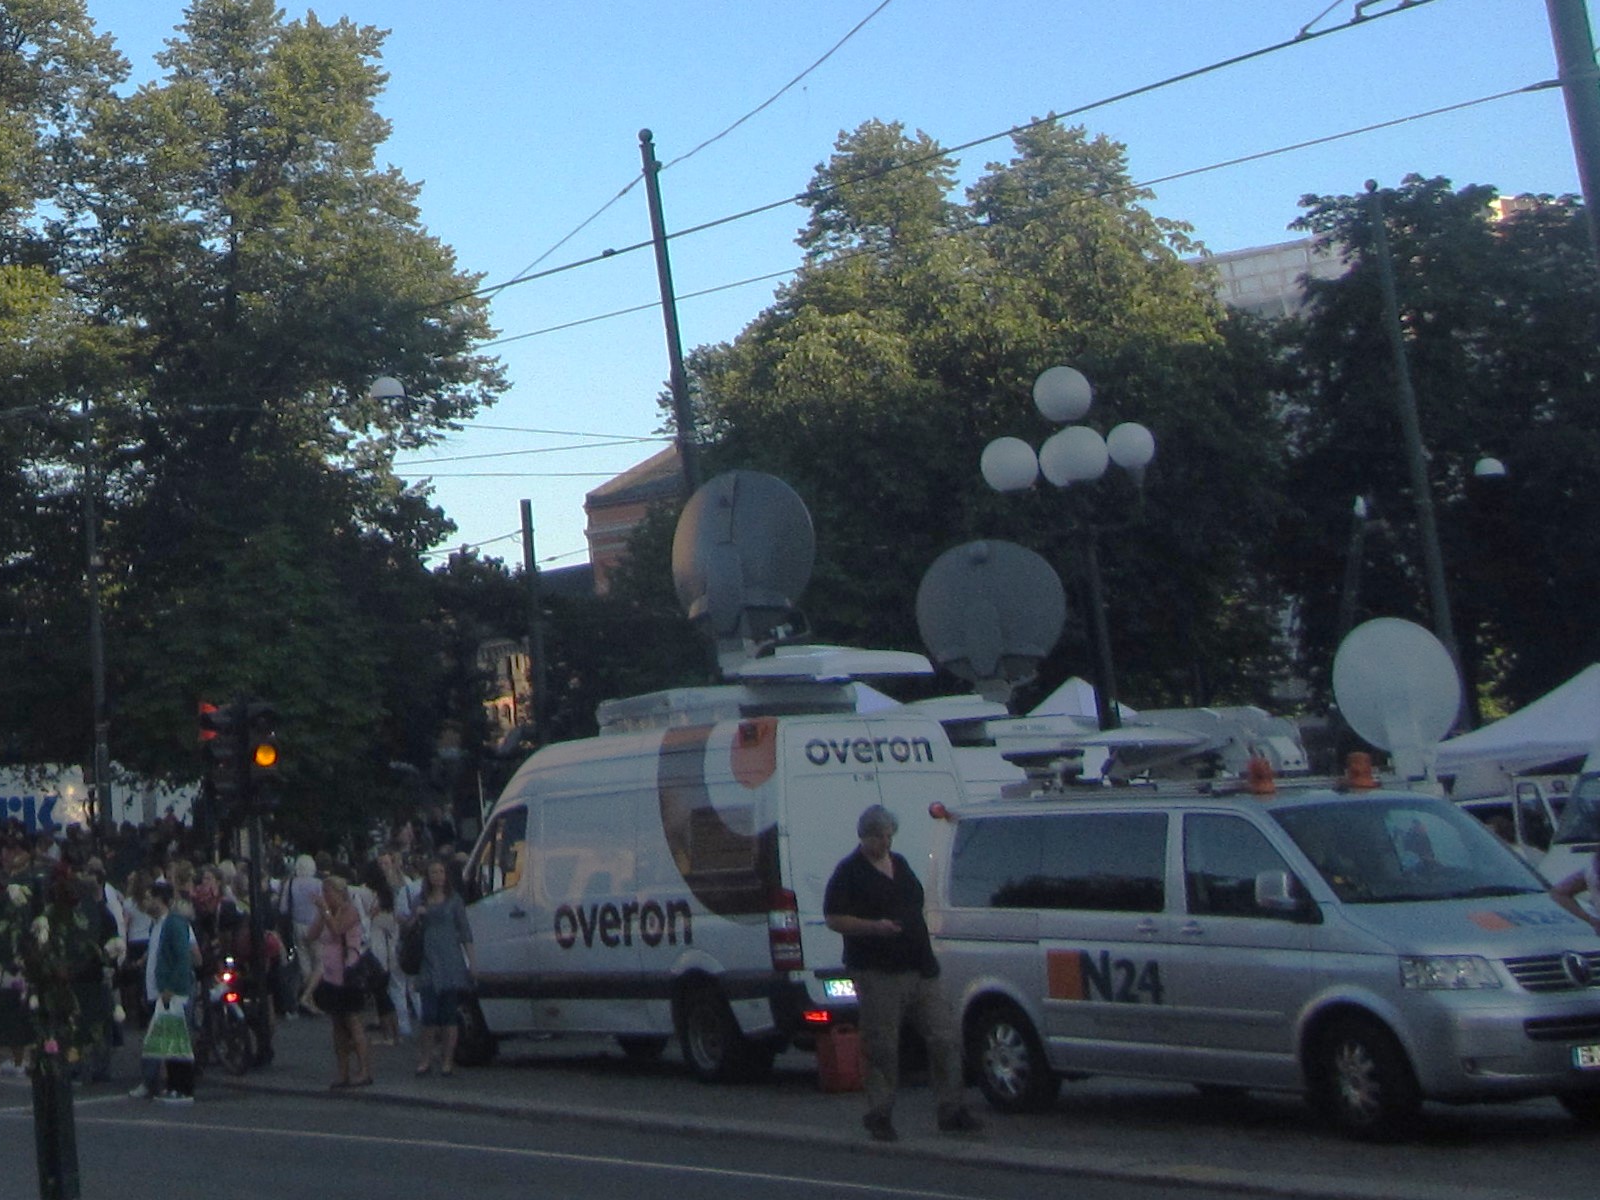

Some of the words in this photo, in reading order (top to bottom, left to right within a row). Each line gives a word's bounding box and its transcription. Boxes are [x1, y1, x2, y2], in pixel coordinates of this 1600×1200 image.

[805, 735, 934, 766] overon
[554, 898, 693, 949] overon
[1080, 948, 1164, 1005] N24
